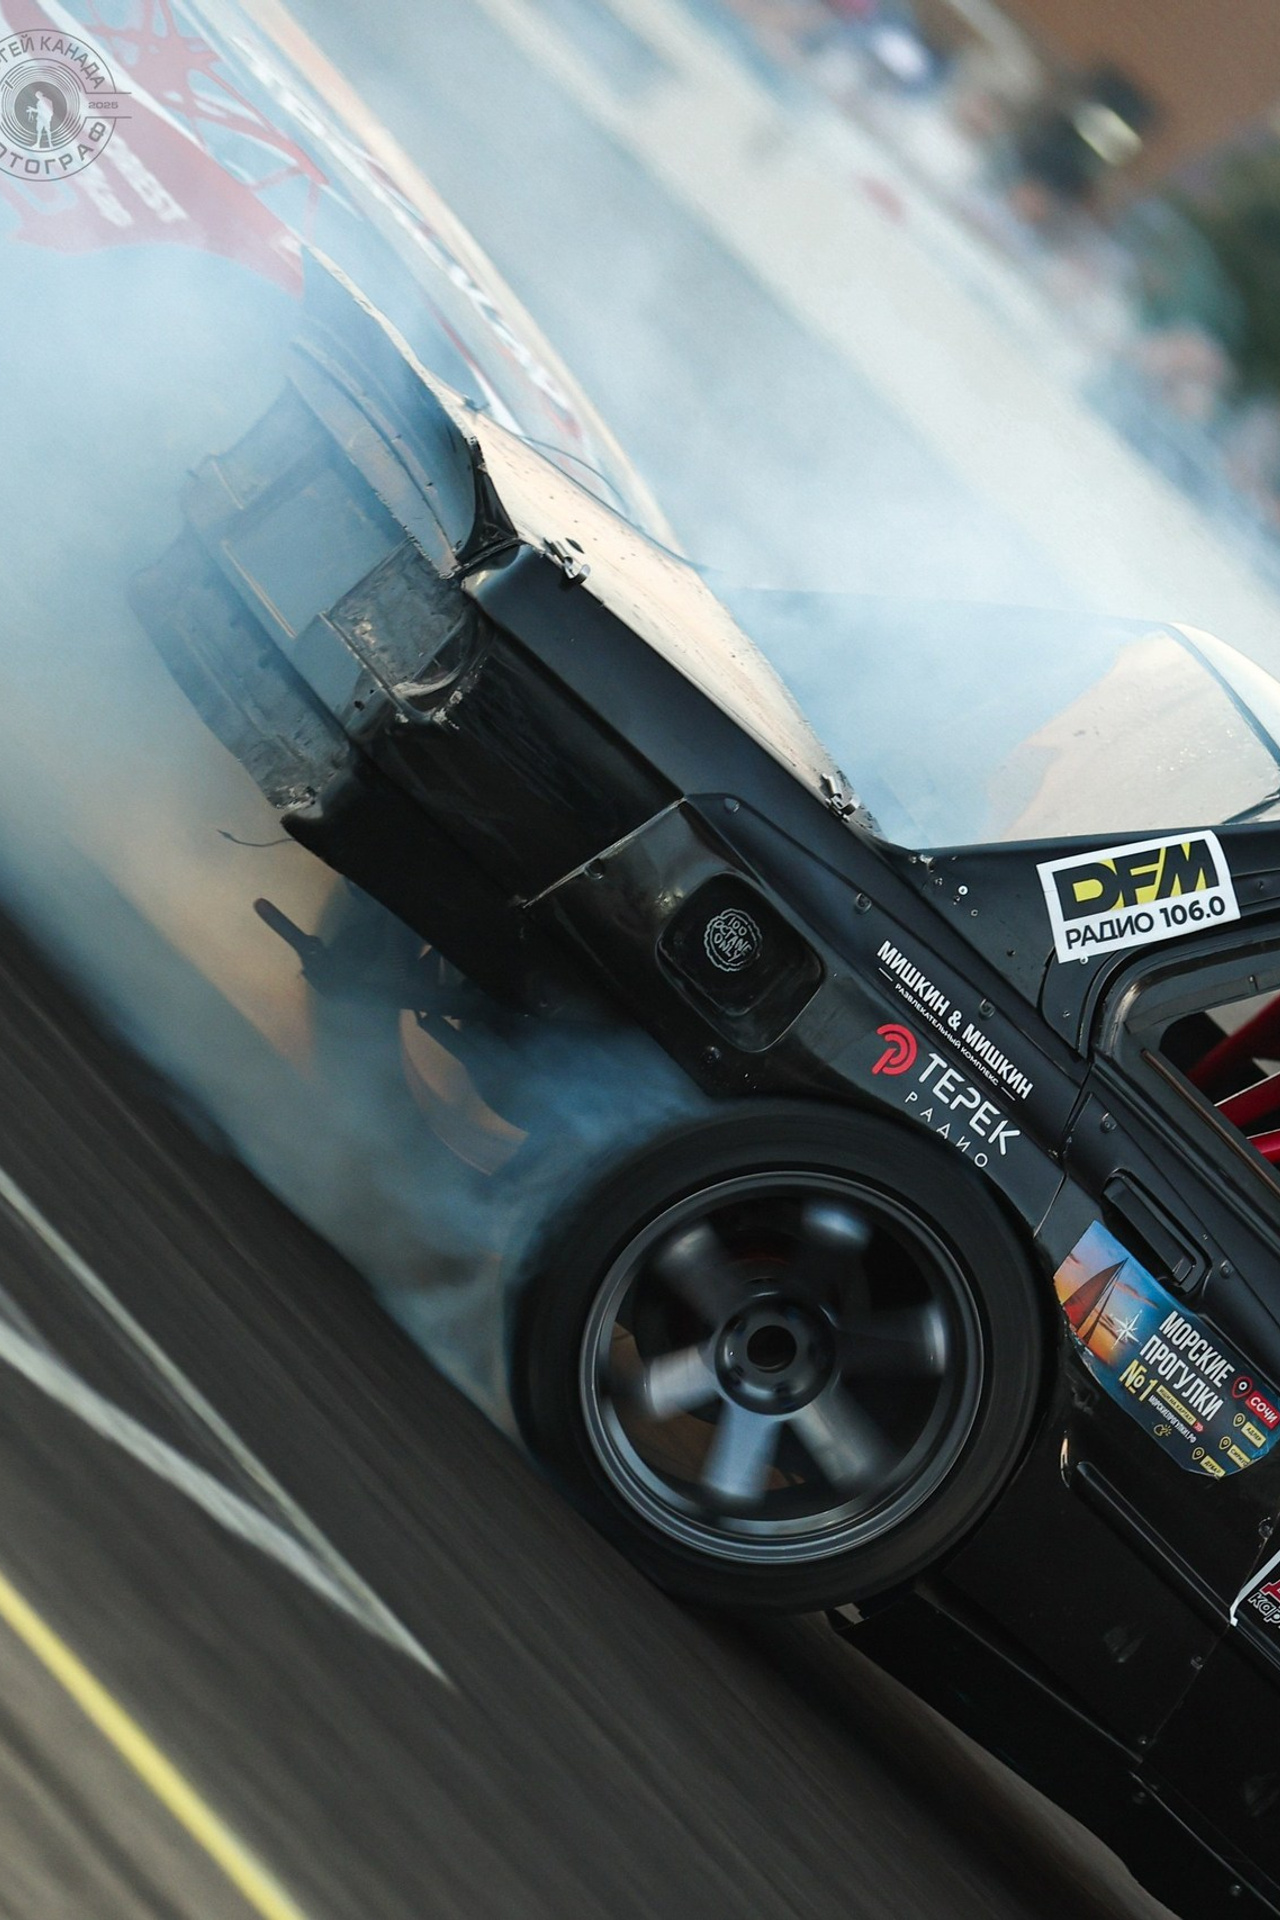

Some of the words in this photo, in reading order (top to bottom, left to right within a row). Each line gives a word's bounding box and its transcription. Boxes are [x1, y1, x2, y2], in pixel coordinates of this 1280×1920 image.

[1052, 839, 1220, 921] DFM
[714, 920, 752, 956] OCTANE
[714, 933, 741, 962] ONLY
[728, 916, 747, 936] 100
[1065, 912, 1154, 950] РАДИО
[1159, 896, 1226, 927] 106.0
[876, 940, 950, 1017] МИШКИН
[948, 1010, 961, 1031] &
[961, 1023, 1034, 1100] МИШКИН
[895, 983, 961, 1050] РАЗВЛЕКАТЕЛЬНЫЙ
[960, 1047, 1000, 1086] КОМПЛЕКС
[904, 1091, 989, 1168] РАДИО
[919, 1052, 1021, 1156] ТЕРЕК
[1139, 1334, 1224, 1421] ПРОГУЛКИ
[1159, 1310, 1235, 1388] МОРСКИЕ
[1246, 1427, 1262, 1441] АДЛЕР
[1250, 1396, 1278, 1423] СОЧИ
